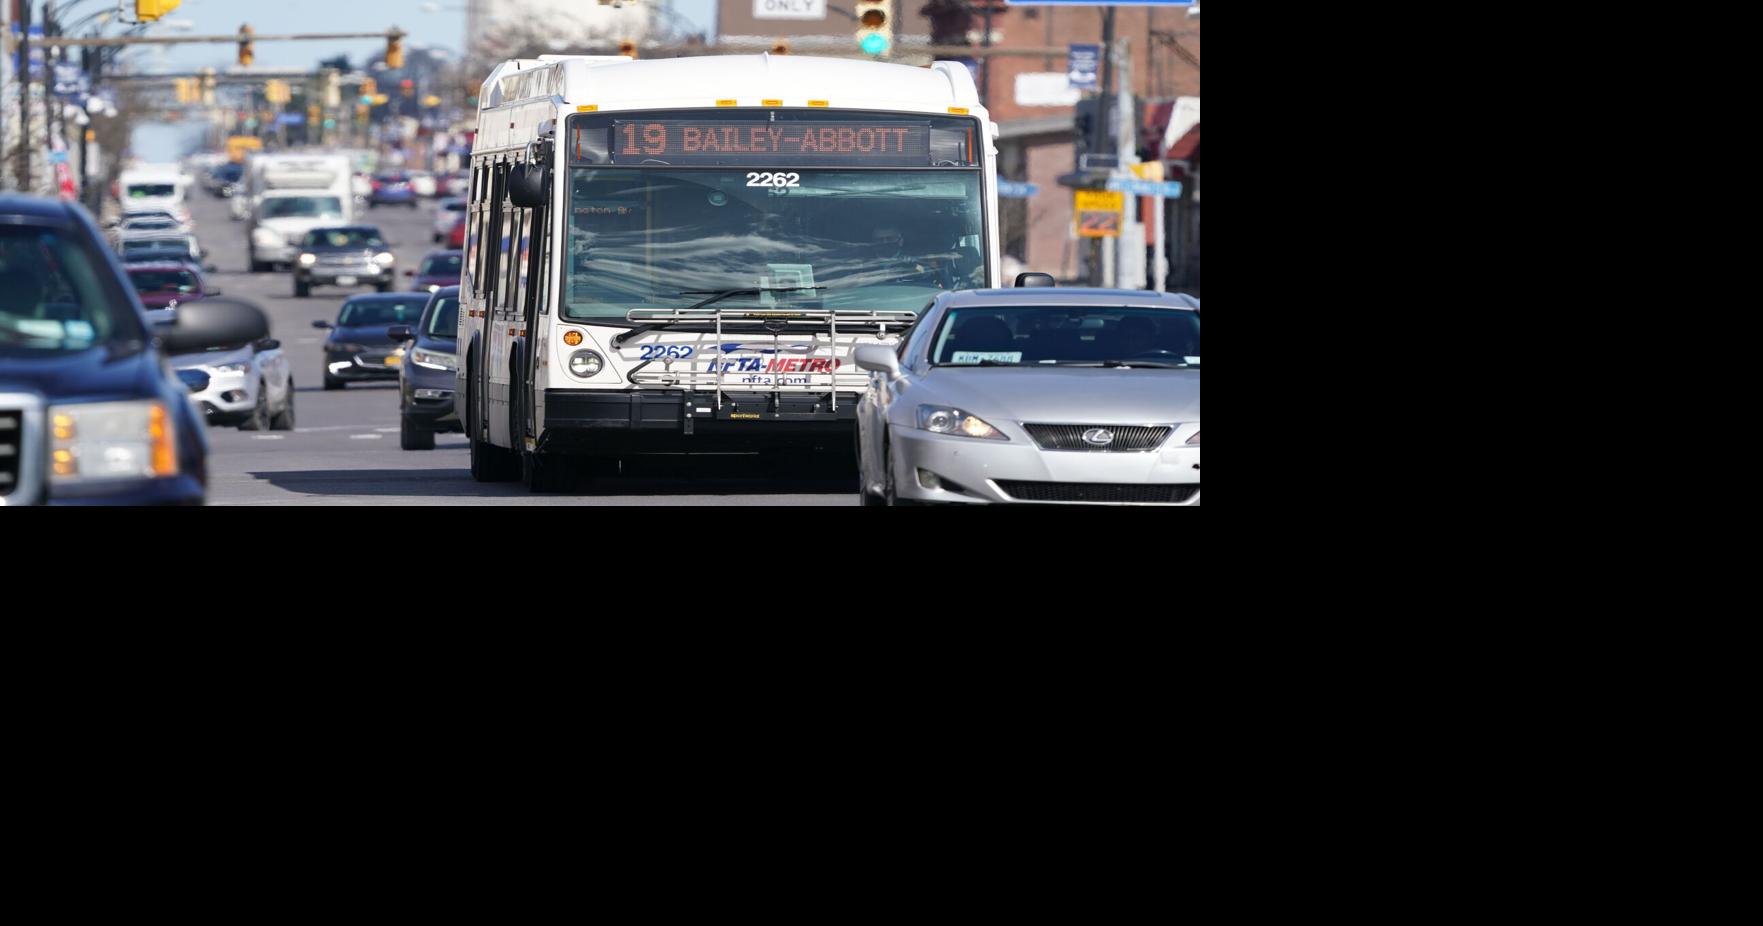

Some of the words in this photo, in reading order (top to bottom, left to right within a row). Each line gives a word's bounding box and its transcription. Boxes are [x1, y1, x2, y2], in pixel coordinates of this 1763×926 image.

[764, 0, 814, 11] ONLY
[622, 123, 666, 155] 19
[683, 127, 909, 152] BAILEY-ABBOTT
[746, 172, 800, 187] 2262
[640, 344, 694, 361] 2262
[741, 374, 808, 385] nftacom
